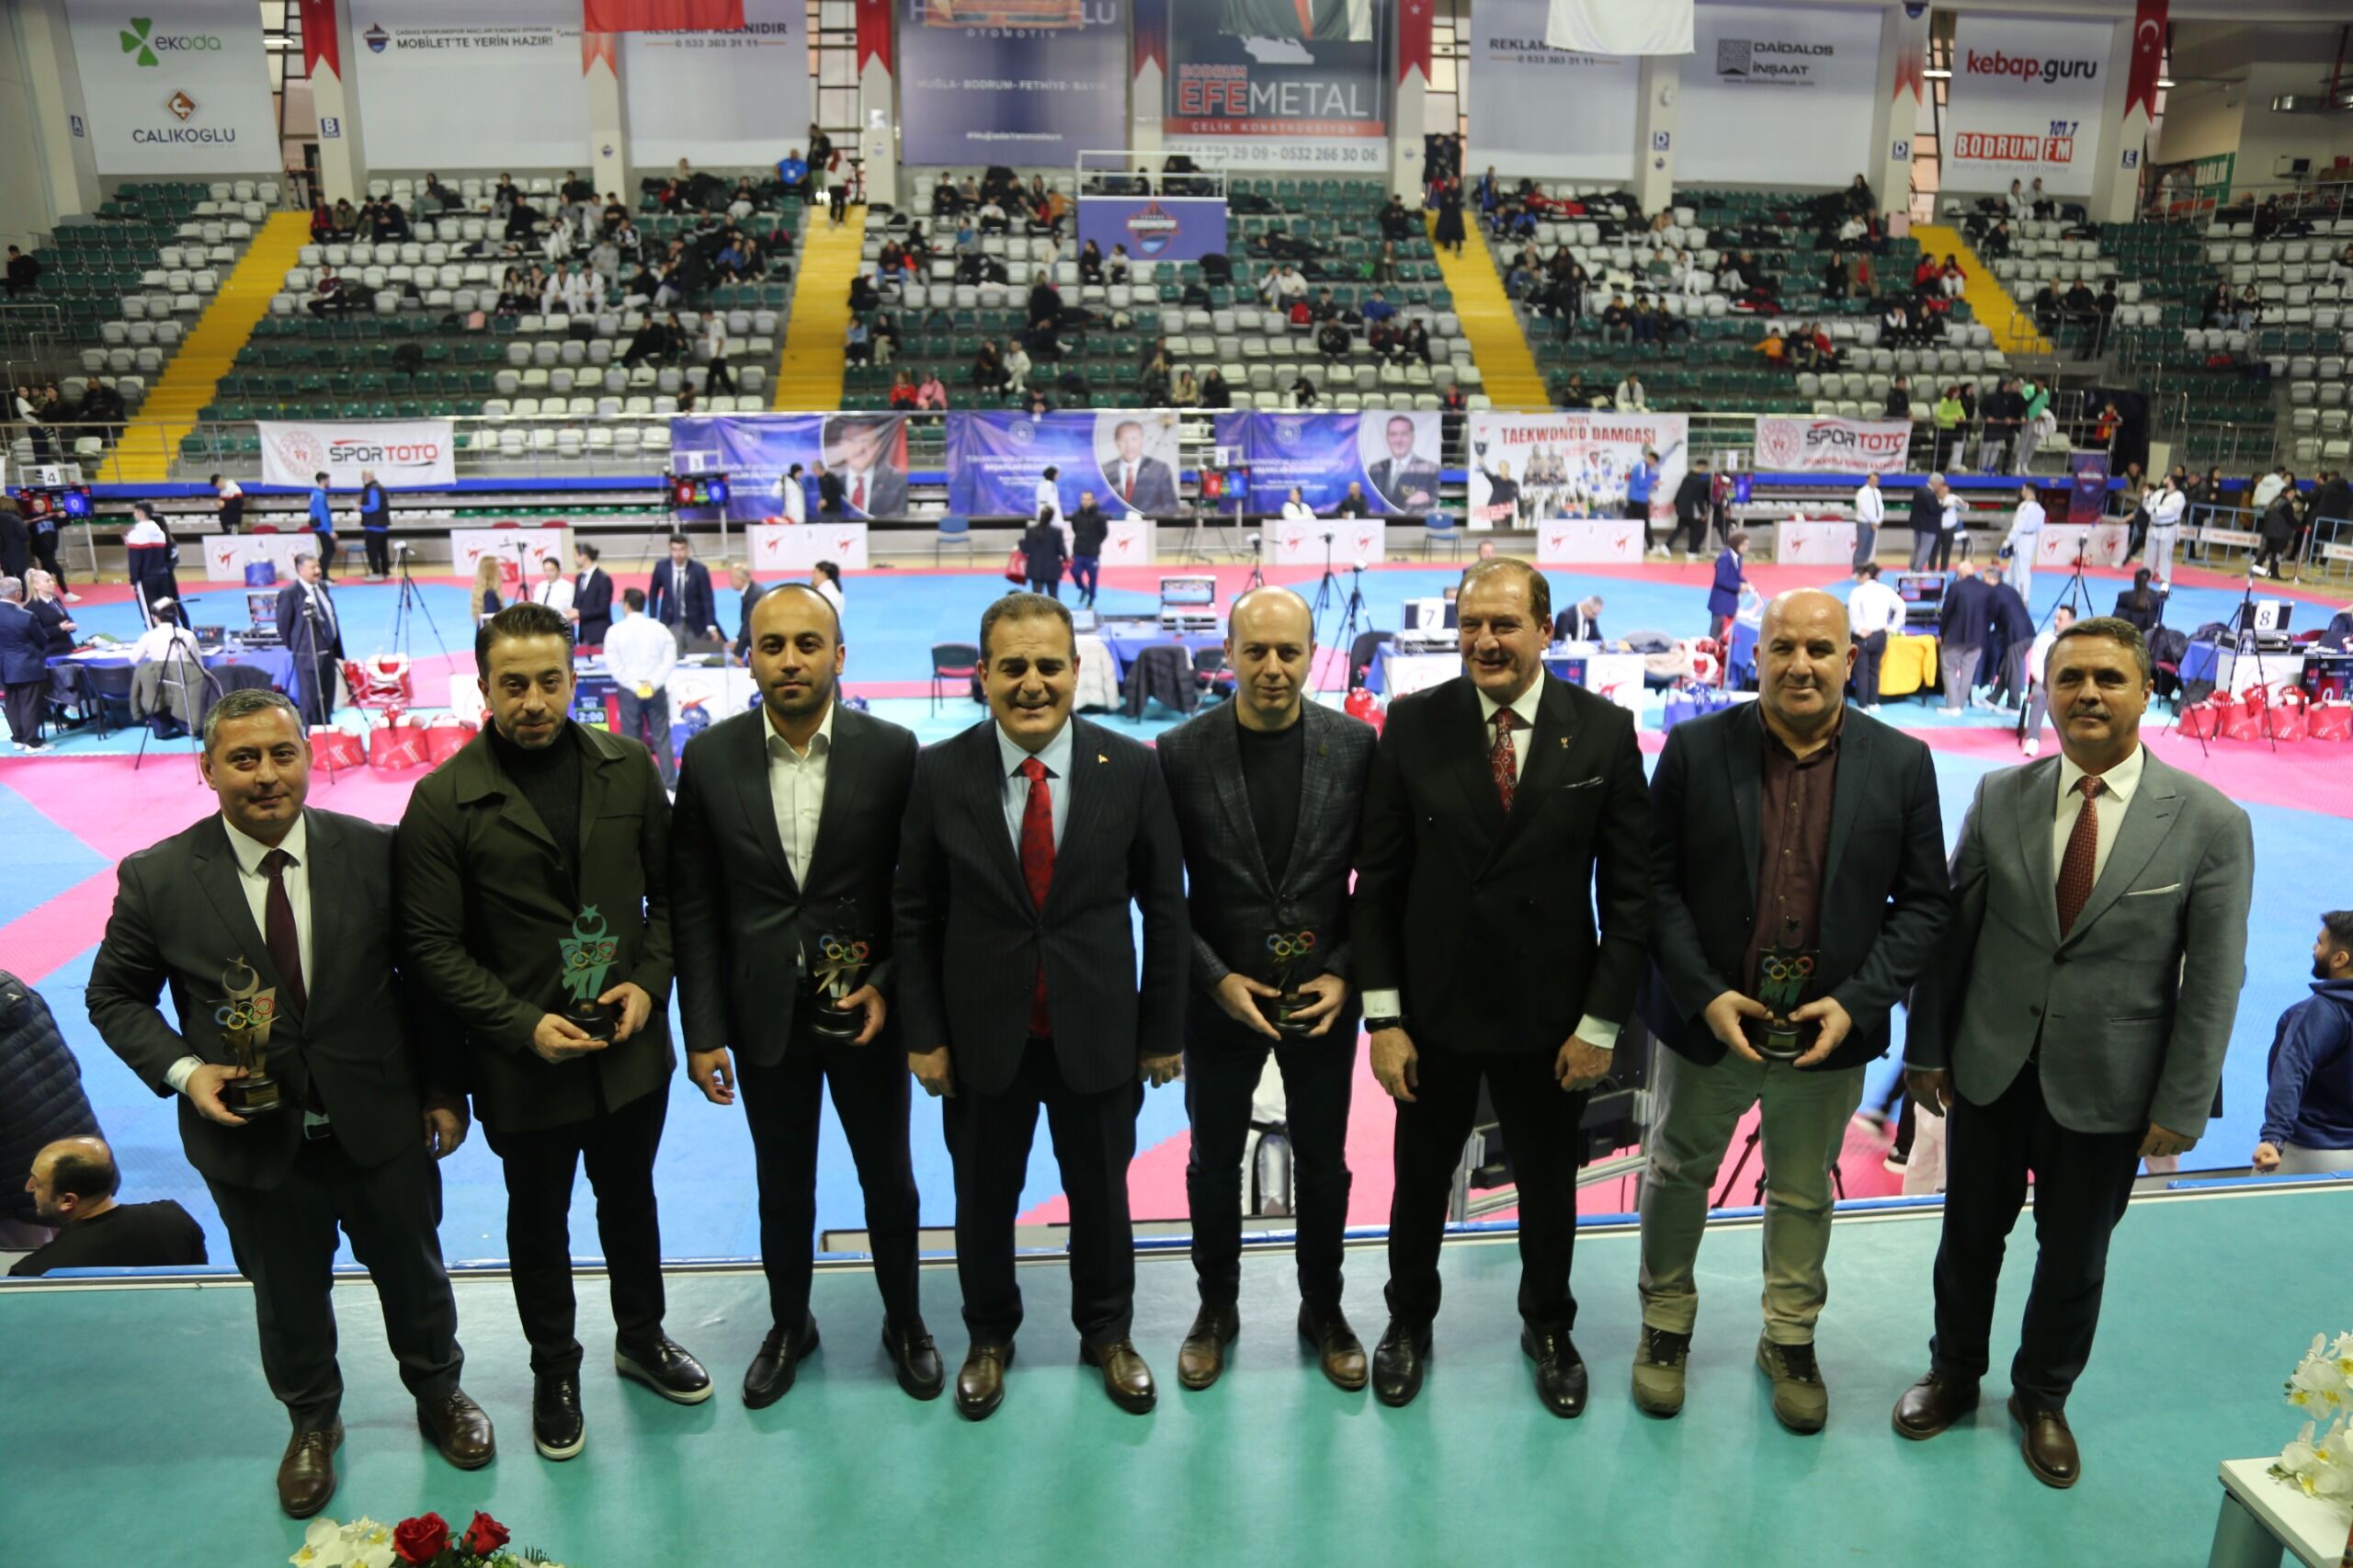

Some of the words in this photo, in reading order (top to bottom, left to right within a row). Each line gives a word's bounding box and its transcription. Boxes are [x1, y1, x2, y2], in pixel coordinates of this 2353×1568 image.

[154, 34, 222, 51] ekoda
[397, 36, 470, 50] MOBİLET'TE
[473, 35, 509, 48] YERİN
[513, 36, 553, 47] HAZIR!
[1752, 62, 1810, 77] İNŞAAT
[1966, 49, 2097, 84] kebap.guru
[324, 119, 336, 132] B
[2050, 120, 2079, 137] 101.7
[1280, 146, 1313, 161] 0532
[1342, 147, 1358, 161] 30
[1361, 147, 1379, 162] 06
[1956, 133, 2039, 162] BODRUM
[2043, 138, 2073, 162] FM
[1502, 426, 1586, 445] TAEKWONDO
[48, 472, 57, 483] 4
[71, 499, 80, 508] 0
[1425, 609, 1436, 627] 7
[2259, 610, 2271, 627] 8
[577, 711, 605, 722] 2:00
